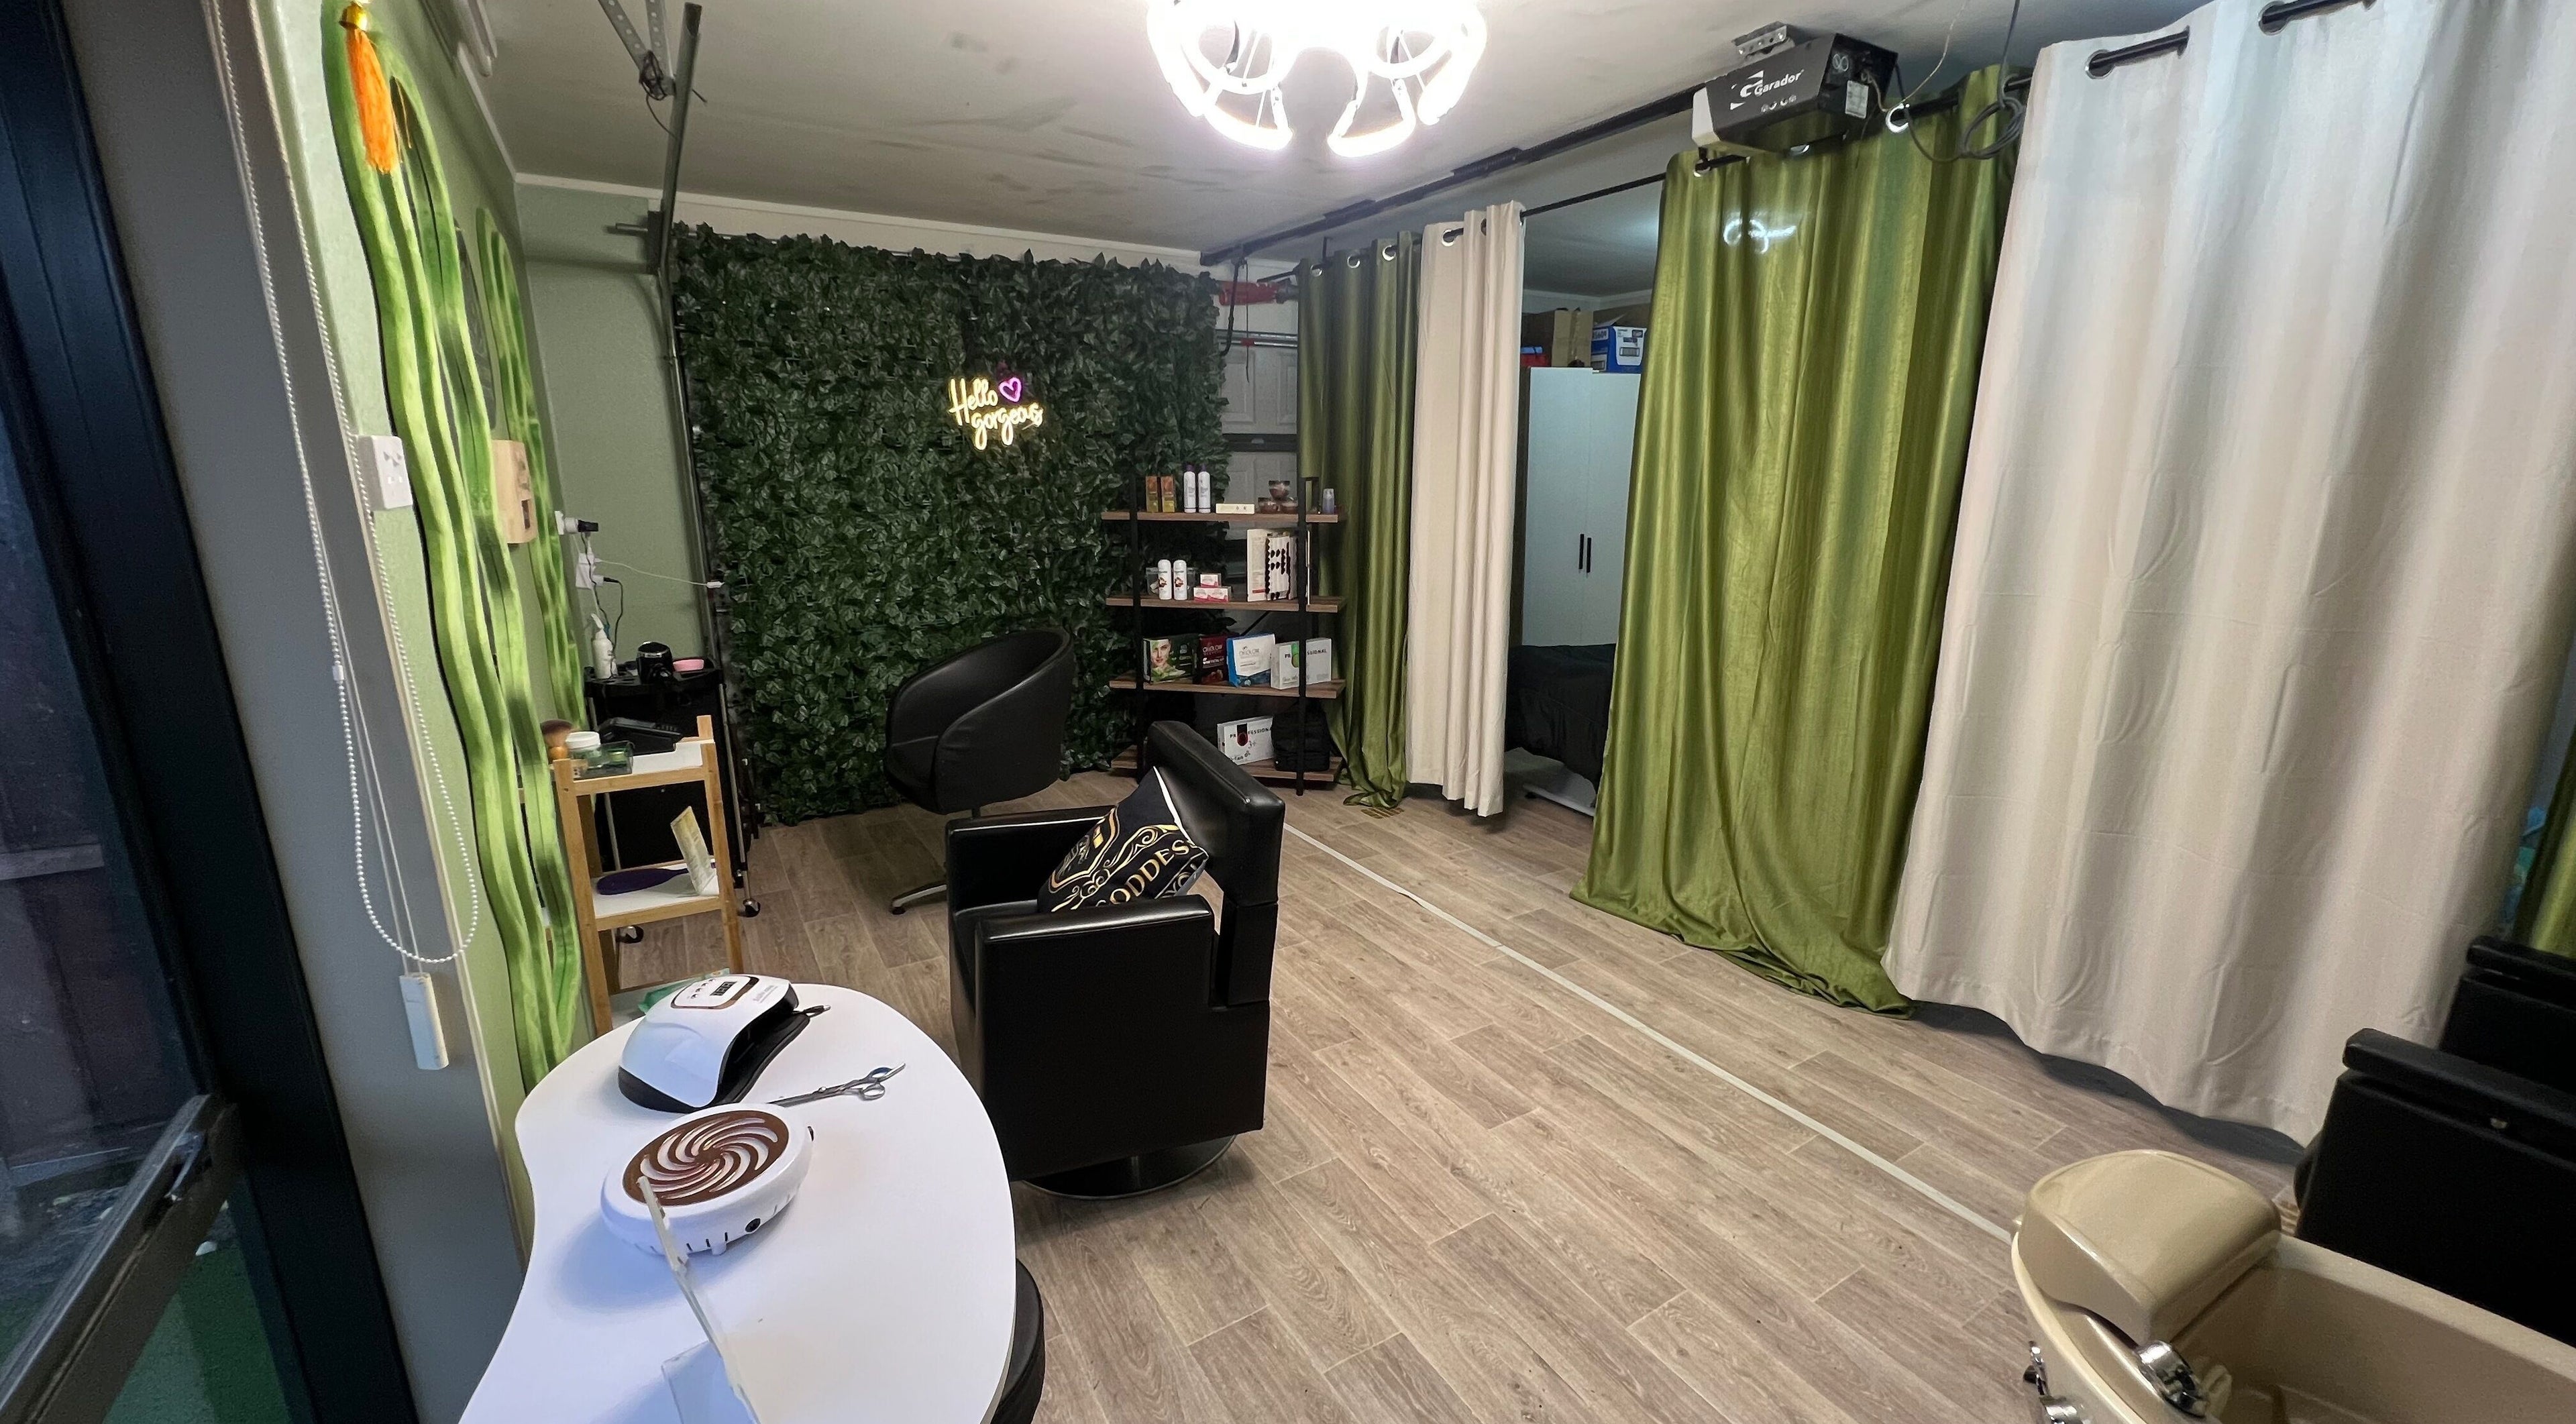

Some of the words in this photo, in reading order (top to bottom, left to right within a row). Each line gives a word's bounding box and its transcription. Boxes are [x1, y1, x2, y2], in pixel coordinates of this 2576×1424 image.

[1754, 71, 1803, 96] Garador
[949, 378, 998, 426] Hello
[1096, 840, 1194, 906] ODDES
